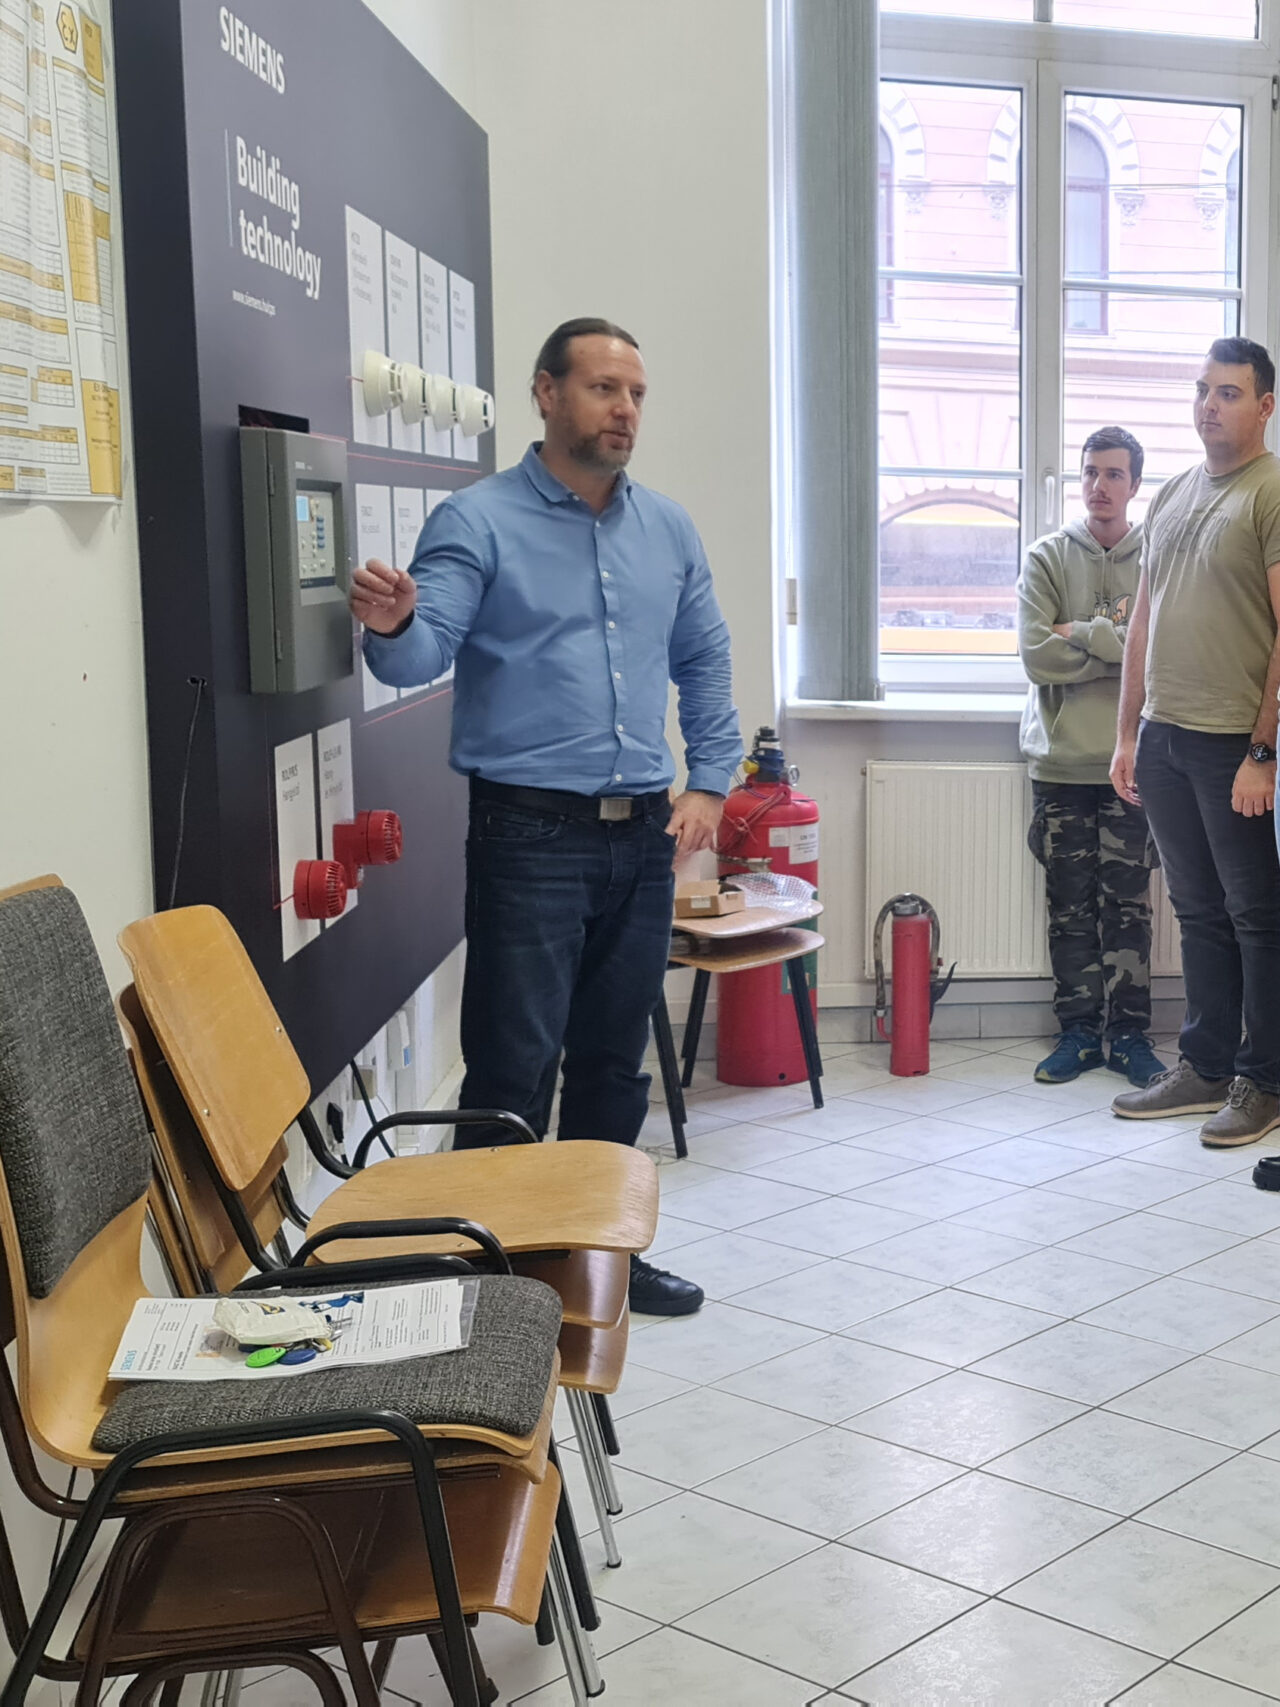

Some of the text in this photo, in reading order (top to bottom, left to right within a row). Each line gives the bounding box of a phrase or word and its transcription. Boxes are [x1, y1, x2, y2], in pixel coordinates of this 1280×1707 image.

[220, 6, 285, 94] SIEMENS
[236, 136, 300, 230] Building
[239, 209, 321, 300] technology
